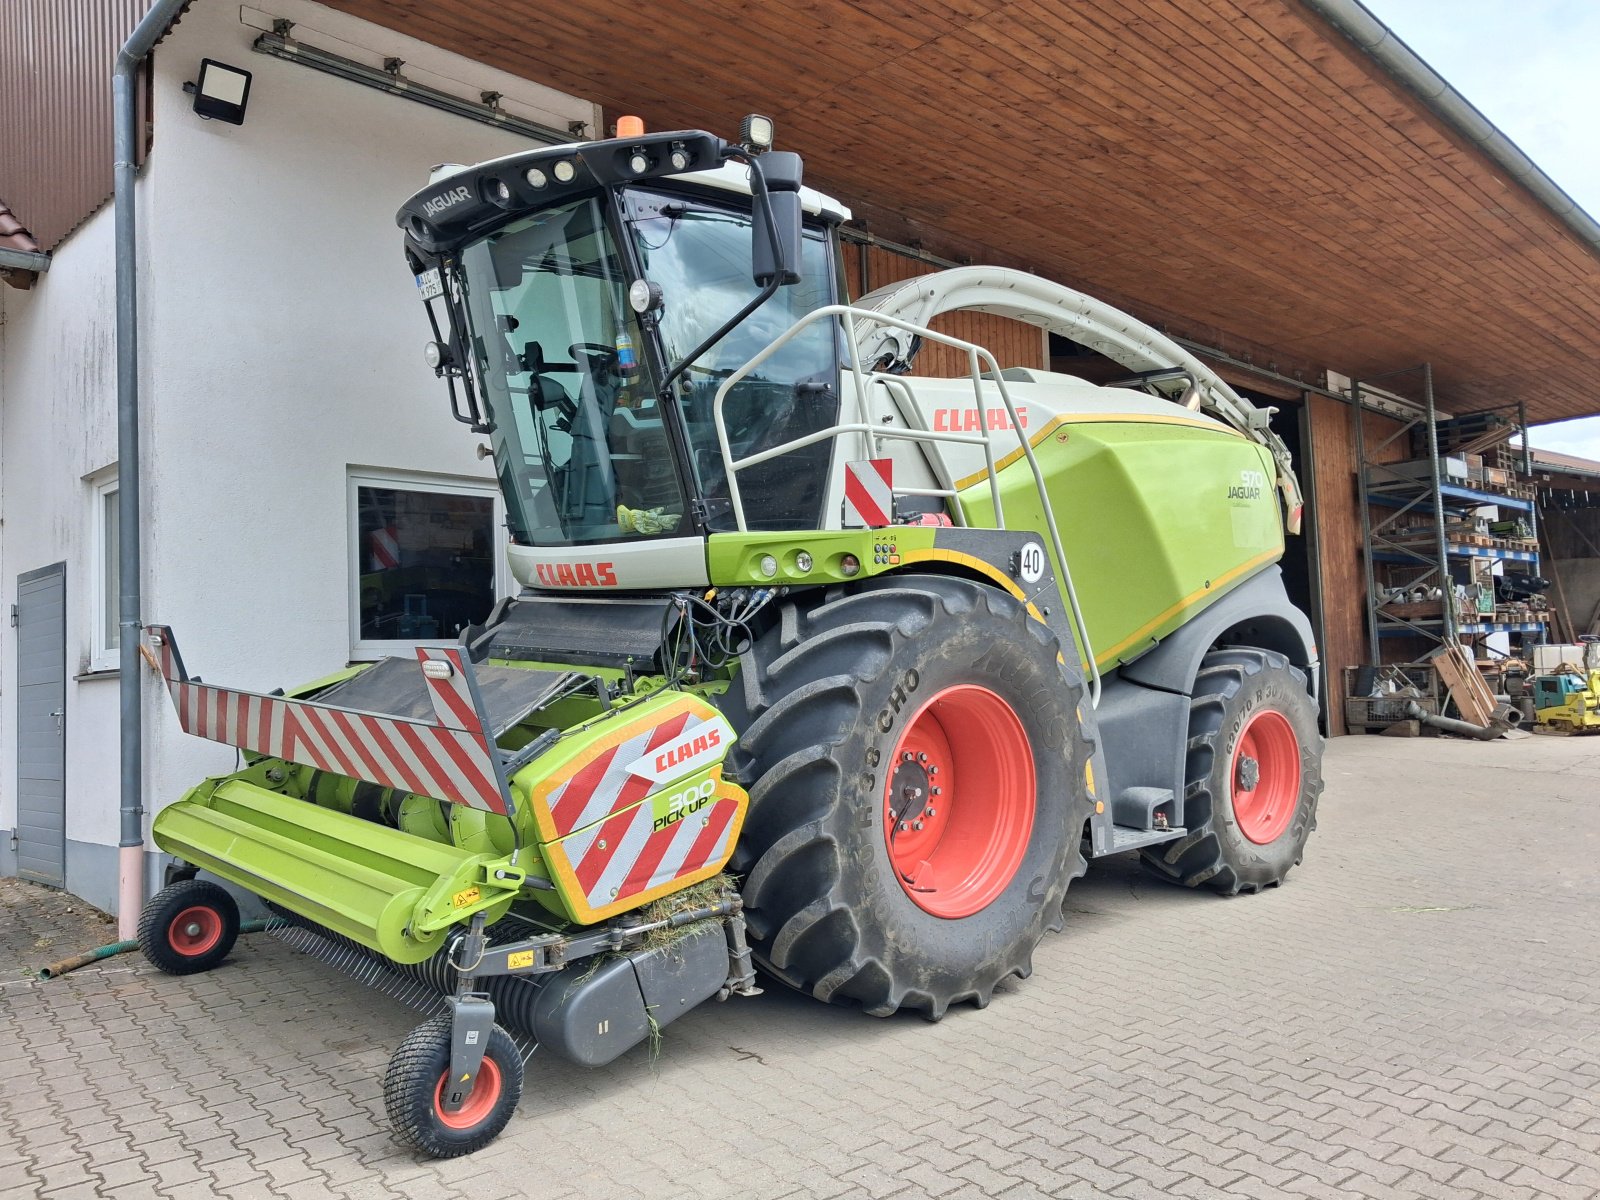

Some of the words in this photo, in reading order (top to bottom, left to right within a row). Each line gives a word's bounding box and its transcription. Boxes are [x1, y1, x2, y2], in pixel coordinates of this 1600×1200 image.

[422, 186, 472, 217] JAGUAR
[934, 407, 1028, 431] CLAAS
[1228, 486, 1261, 500] JAGUAR
[1241, 470, 1262, 487] 970
[536, 563, 617, 586] CLAAS
[1023, 549, 1040, 574] 40
[878, 668, 919, 734] CHO
[1226, 700, 1252, 755] 620/70
[1256, 689, 1263, 702] R
[1266, 685, 1278, 698] 30
[655, 729, 721, 774] CLAAS
[860, 746, 880, 792] 38
[668, 778, 716, 815] 300
[653, 806, 685, 832] PICK
[688, 796, 709, 815] UP
[856, 806, 872, 829] R
